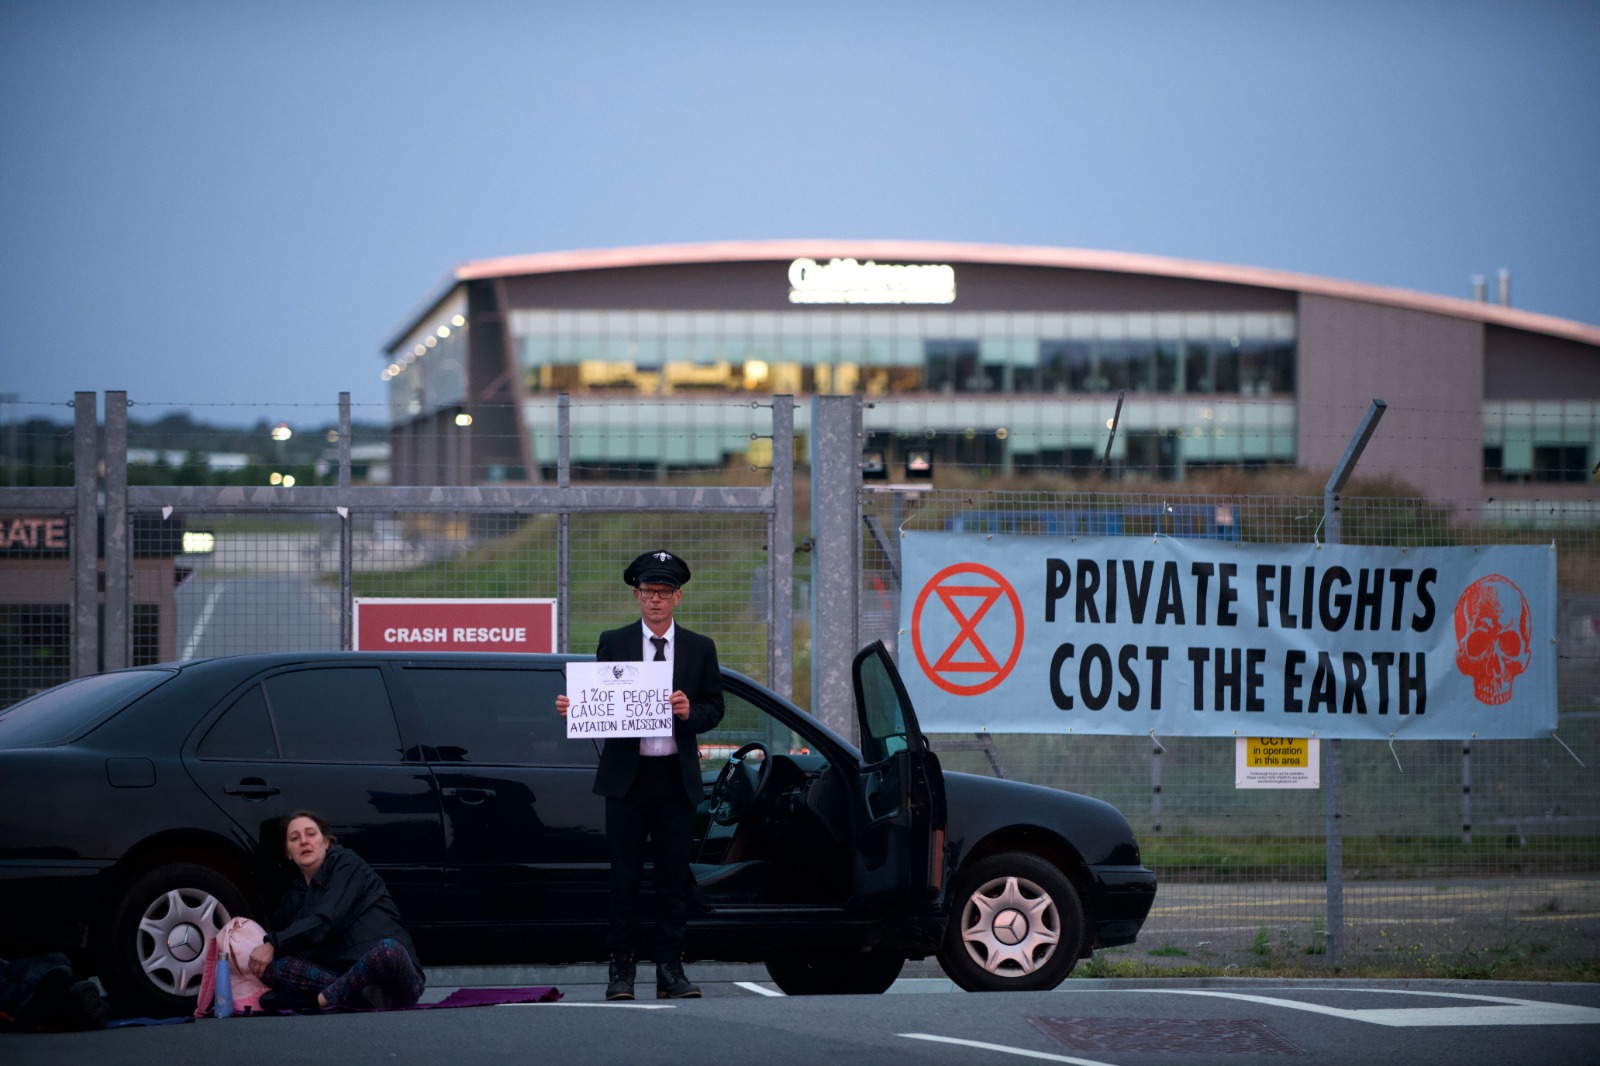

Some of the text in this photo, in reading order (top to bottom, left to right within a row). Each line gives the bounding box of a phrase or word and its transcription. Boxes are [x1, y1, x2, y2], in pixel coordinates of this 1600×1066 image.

[1045, 558, 1437, 632] PRIVATE FLIGHTS
[384, 628, 526, 643] CRASH RESCUE
[1050, 643, 1427, 715] COST THE EARTH
[623, 689, 670, 704] PEOPLE
[571, 702, 671, 719] CAUSE 50% OF
[570, 718, 672, 733] AVIATION EMISSIONS
[1253, 746, 1302, 756] in operation
[1254, 756, 1301, 765] in this area
